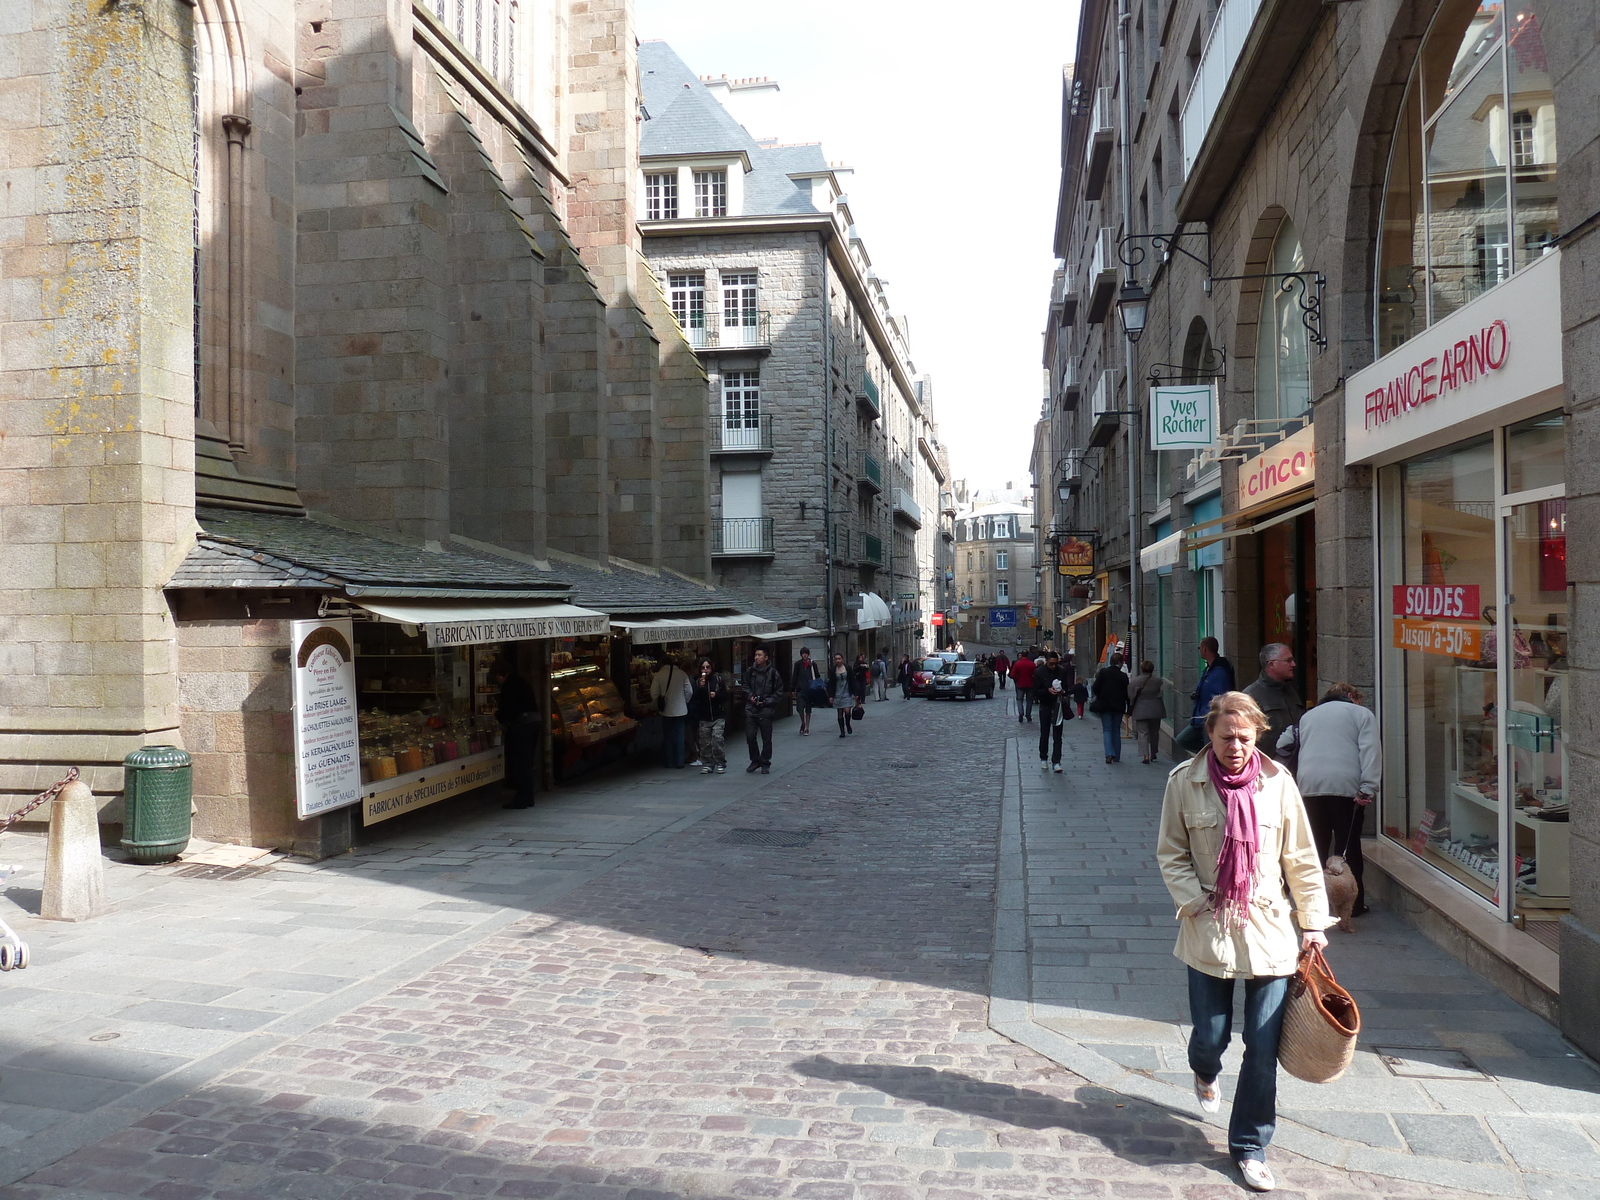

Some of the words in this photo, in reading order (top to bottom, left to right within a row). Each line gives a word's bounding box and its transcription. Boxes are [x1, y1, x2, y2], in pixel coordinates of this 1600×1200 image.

[1365, 357, 1437, 431] FRANCE
[1438, 319, 1511, 396] ARNO
[1170, 399, 1197, 418] Yves
[1162, 415, 1206, 434] Rocher
[1247, 451, 1306, 496] cinco
[1405, 586, 1464, 617] SOLDES
[435, 626, 482, 644] FABRICANT
[485, 624, 494, 640] DE
[497, 621, 536, 639] SPECIALITES
[538, 620, 547, 636] DE
[555, 620, 571, 634] MALO
[573, 619, 592, 633] DEPUIS
[306, 704, 314, 712] Les
[314, 700, 329, 711] BRISE
[329, 697, 347, 707] LAMES
[302, 751, 310, 759] Les
[308, 763, 317, 771] Les
[306, 801, 324, 812] Patates
[324, 797, 332, 806] de
[332, 794, 338, 803] St
[339, 789, 355, 802] MALO
[369, 795, 404, 816] FABRICANT
[405, 791, 412, 804] de
[413, 782, 447, 801] SPECIALITES
[447, 779, 454, 791] de
[460, 771, 475, 786] MALO
[475, 767, 491, 783] depuis
